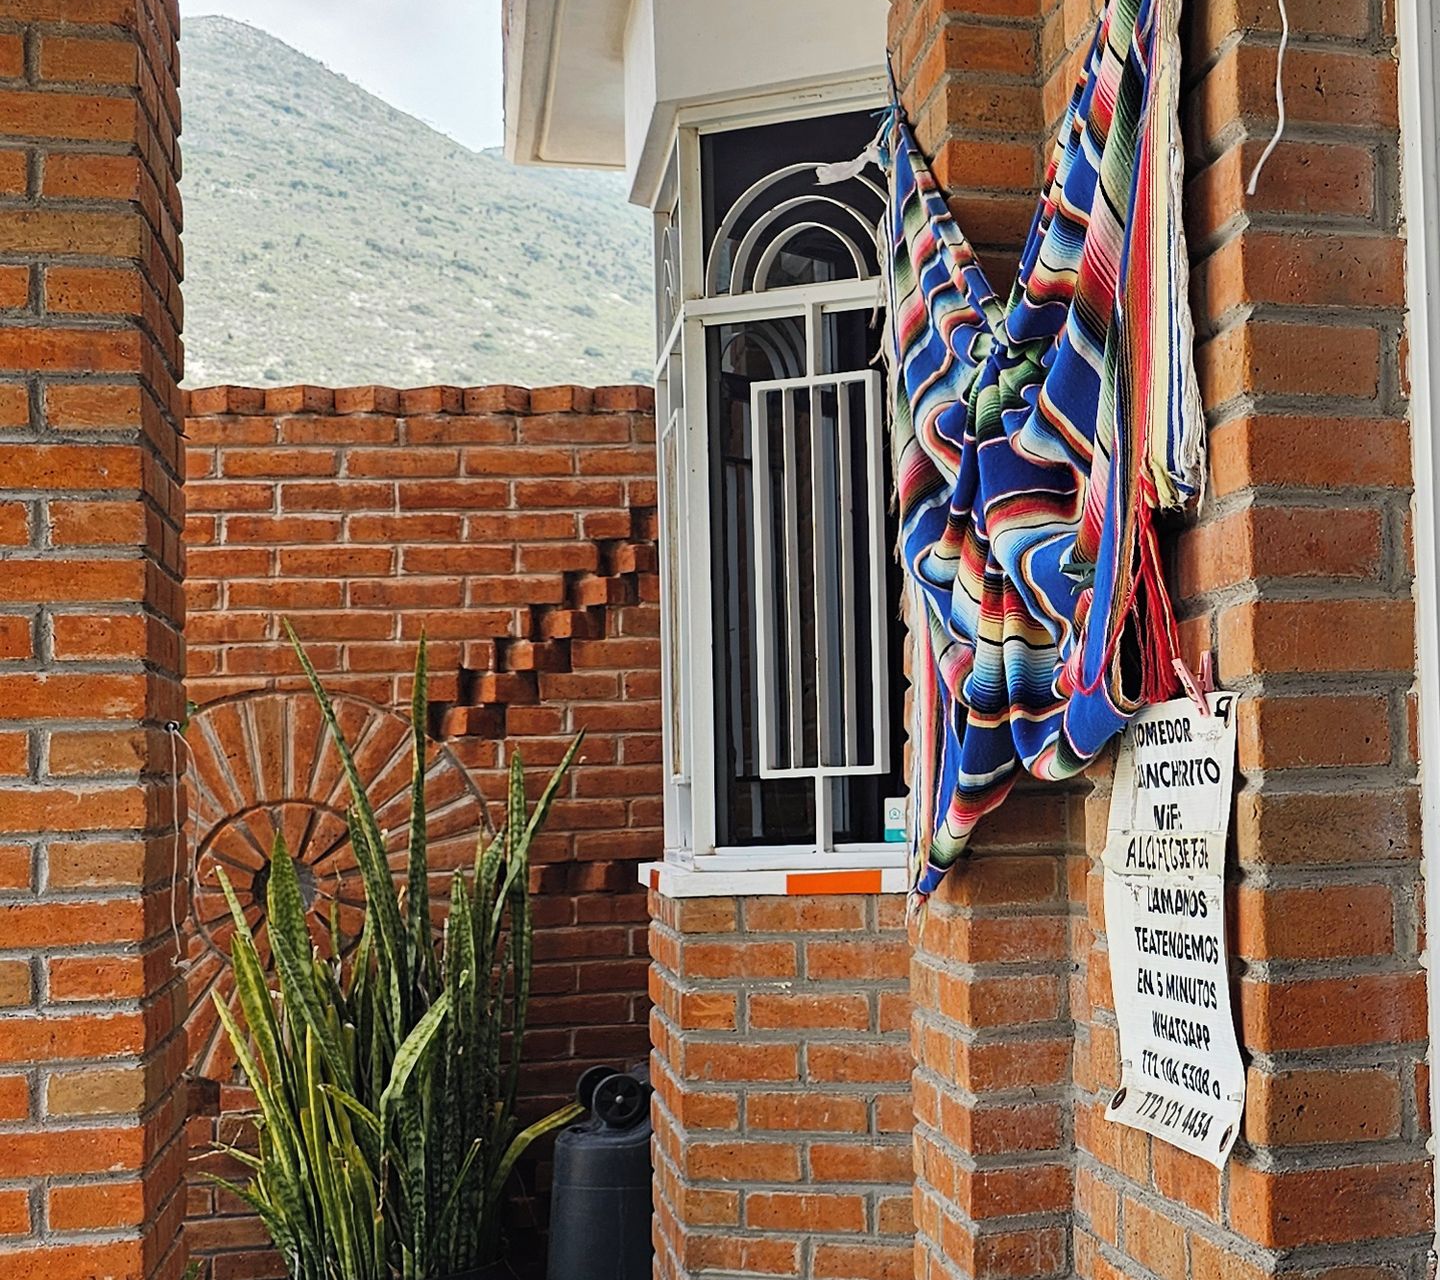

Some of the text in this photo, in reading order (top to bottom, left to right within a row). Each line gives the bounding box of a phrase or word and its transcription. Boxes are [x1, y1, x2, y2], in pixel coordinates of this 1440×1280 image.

[1135, 717, 1192, 747] OMEDOR
[1137, 968, 1217, 1010] EN 5 MINUTOS
[1152, 1010, 1211, 1051] WHATSAPP
[1141, 1049, 1160, 1079] 772
[1160, 1056, 1180, 1086] 106
[1182, 1063, 1210, 1096] 5308
[1136, 1091, 1214, 1141] 772 121 4434
